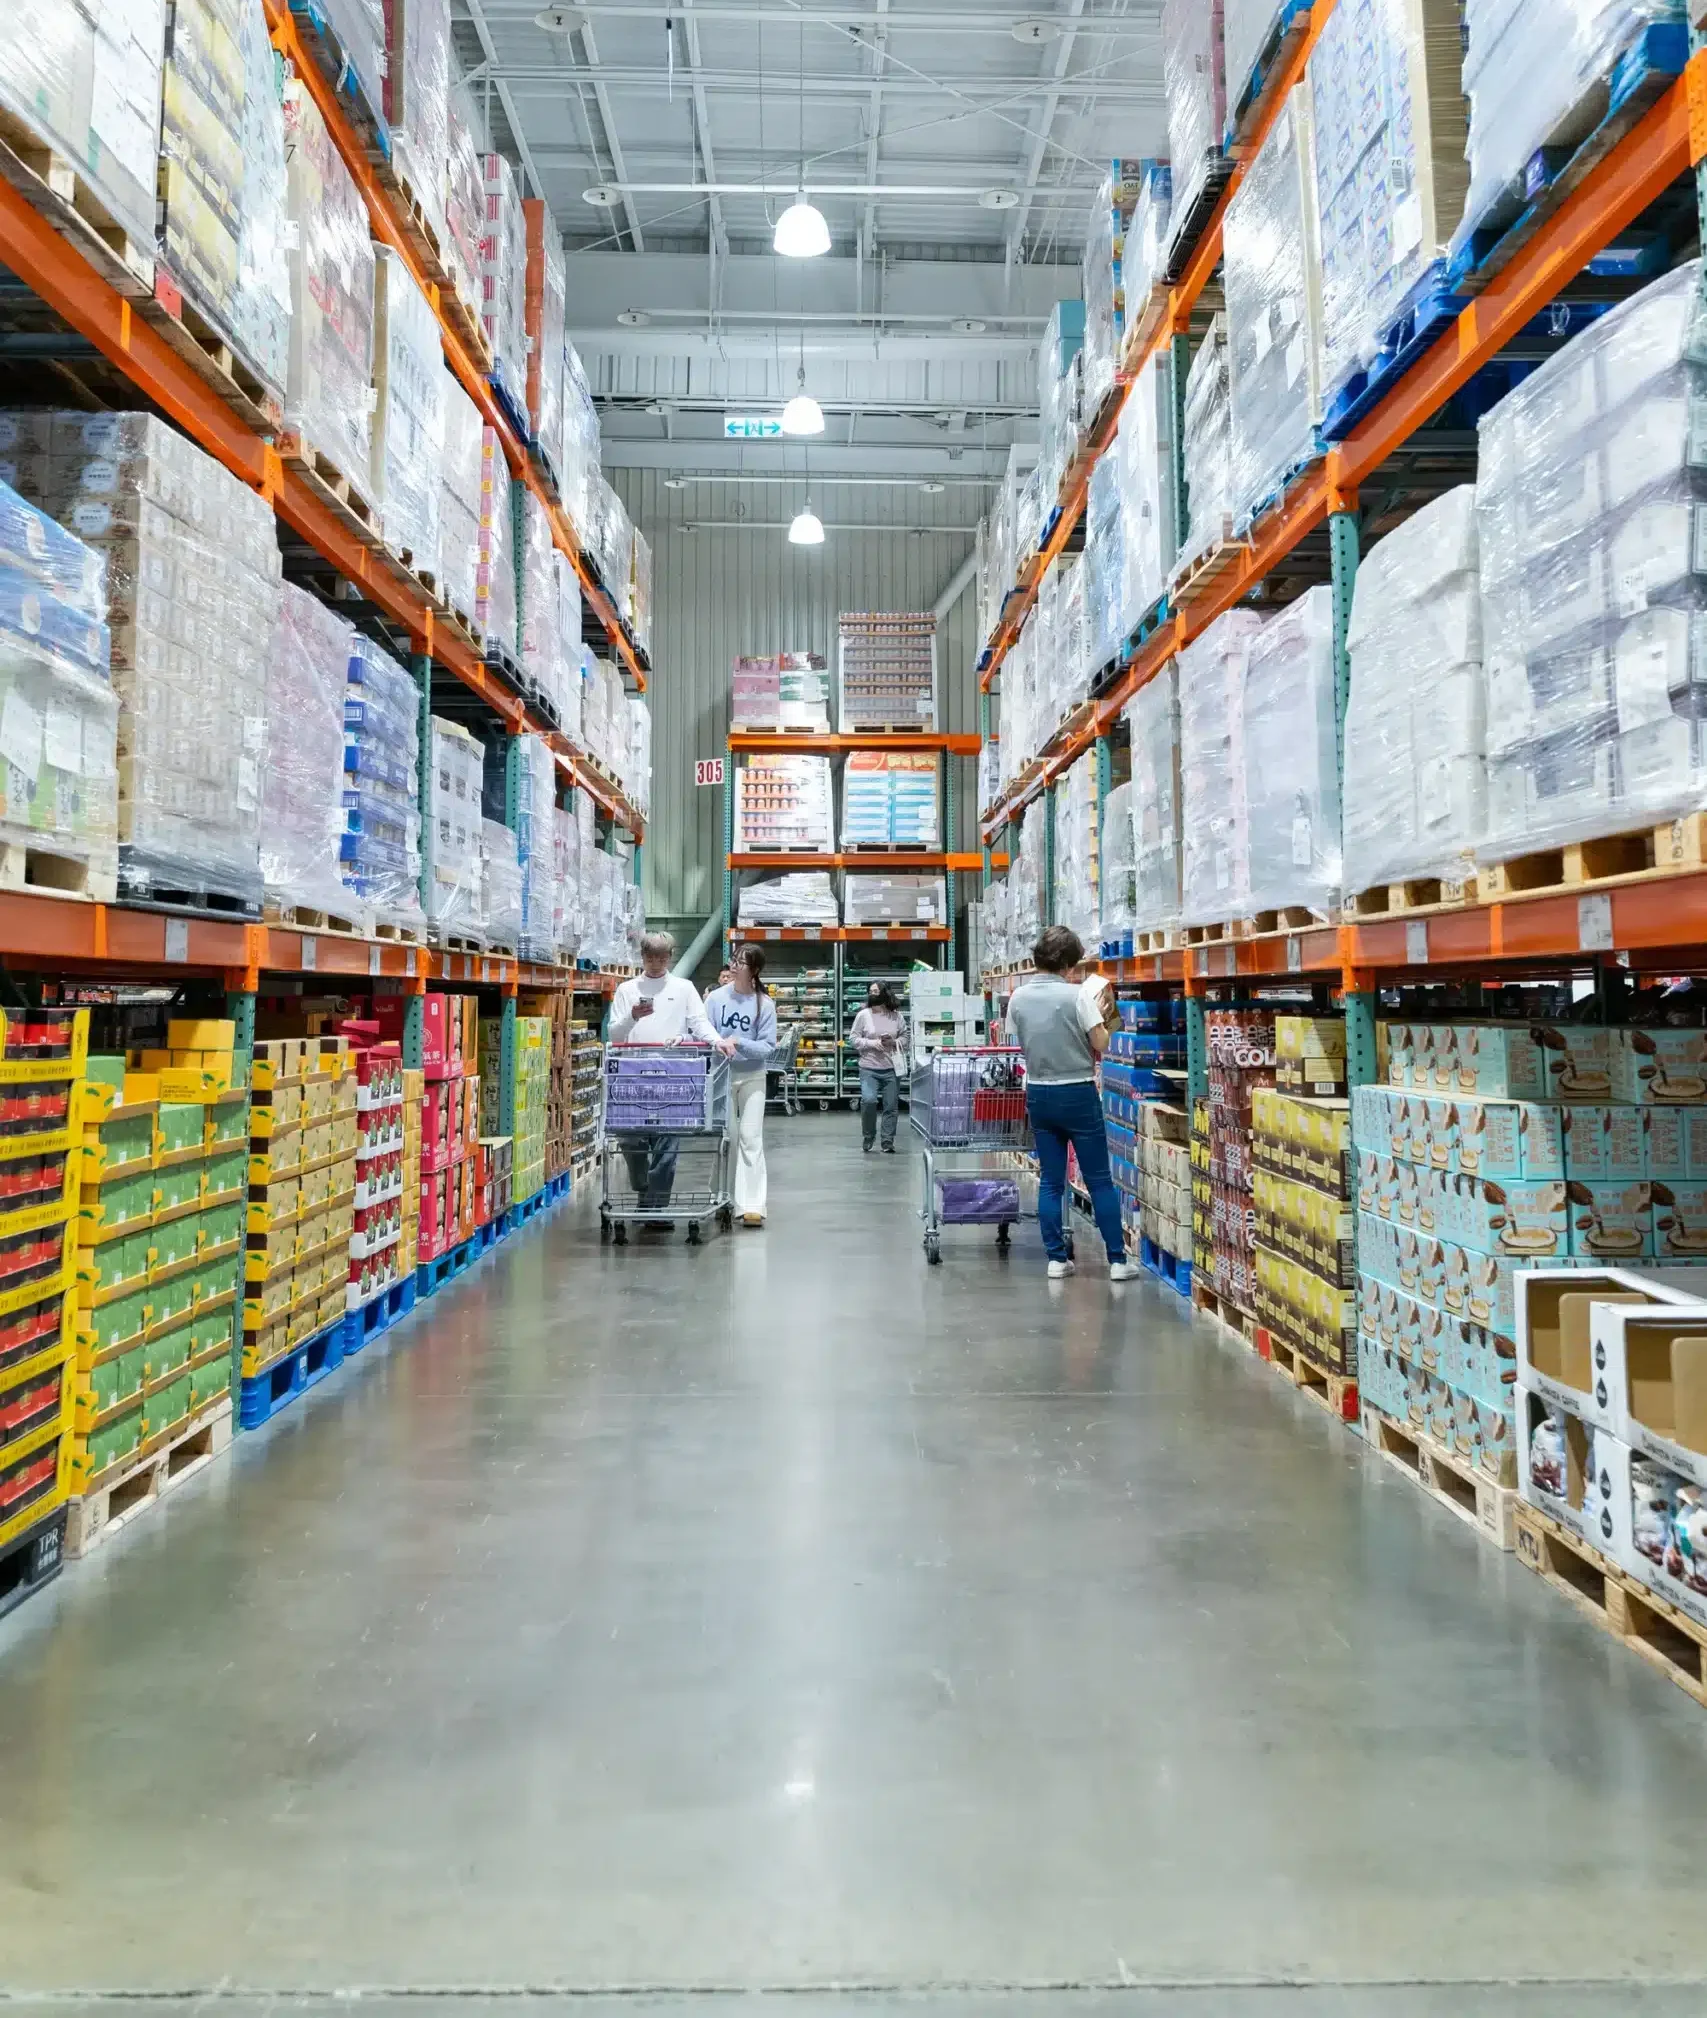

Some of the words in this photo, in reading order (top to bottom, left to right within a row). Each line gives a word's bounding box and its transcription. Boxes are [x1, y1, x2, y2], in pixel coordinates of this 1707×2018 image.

[697, 761, 723, 784] 305
[721, 1005, 751, 1032] Lee
[1504, 1116, 1515, 1163] LATTE
[1546, 1116, 1557, 1164] LATTE
[1589, 1117, 1600, 1165] LATTE
[1628, 1117, 1640, 1165] LATTE
[40, 1527, 59, 1553] TPR
